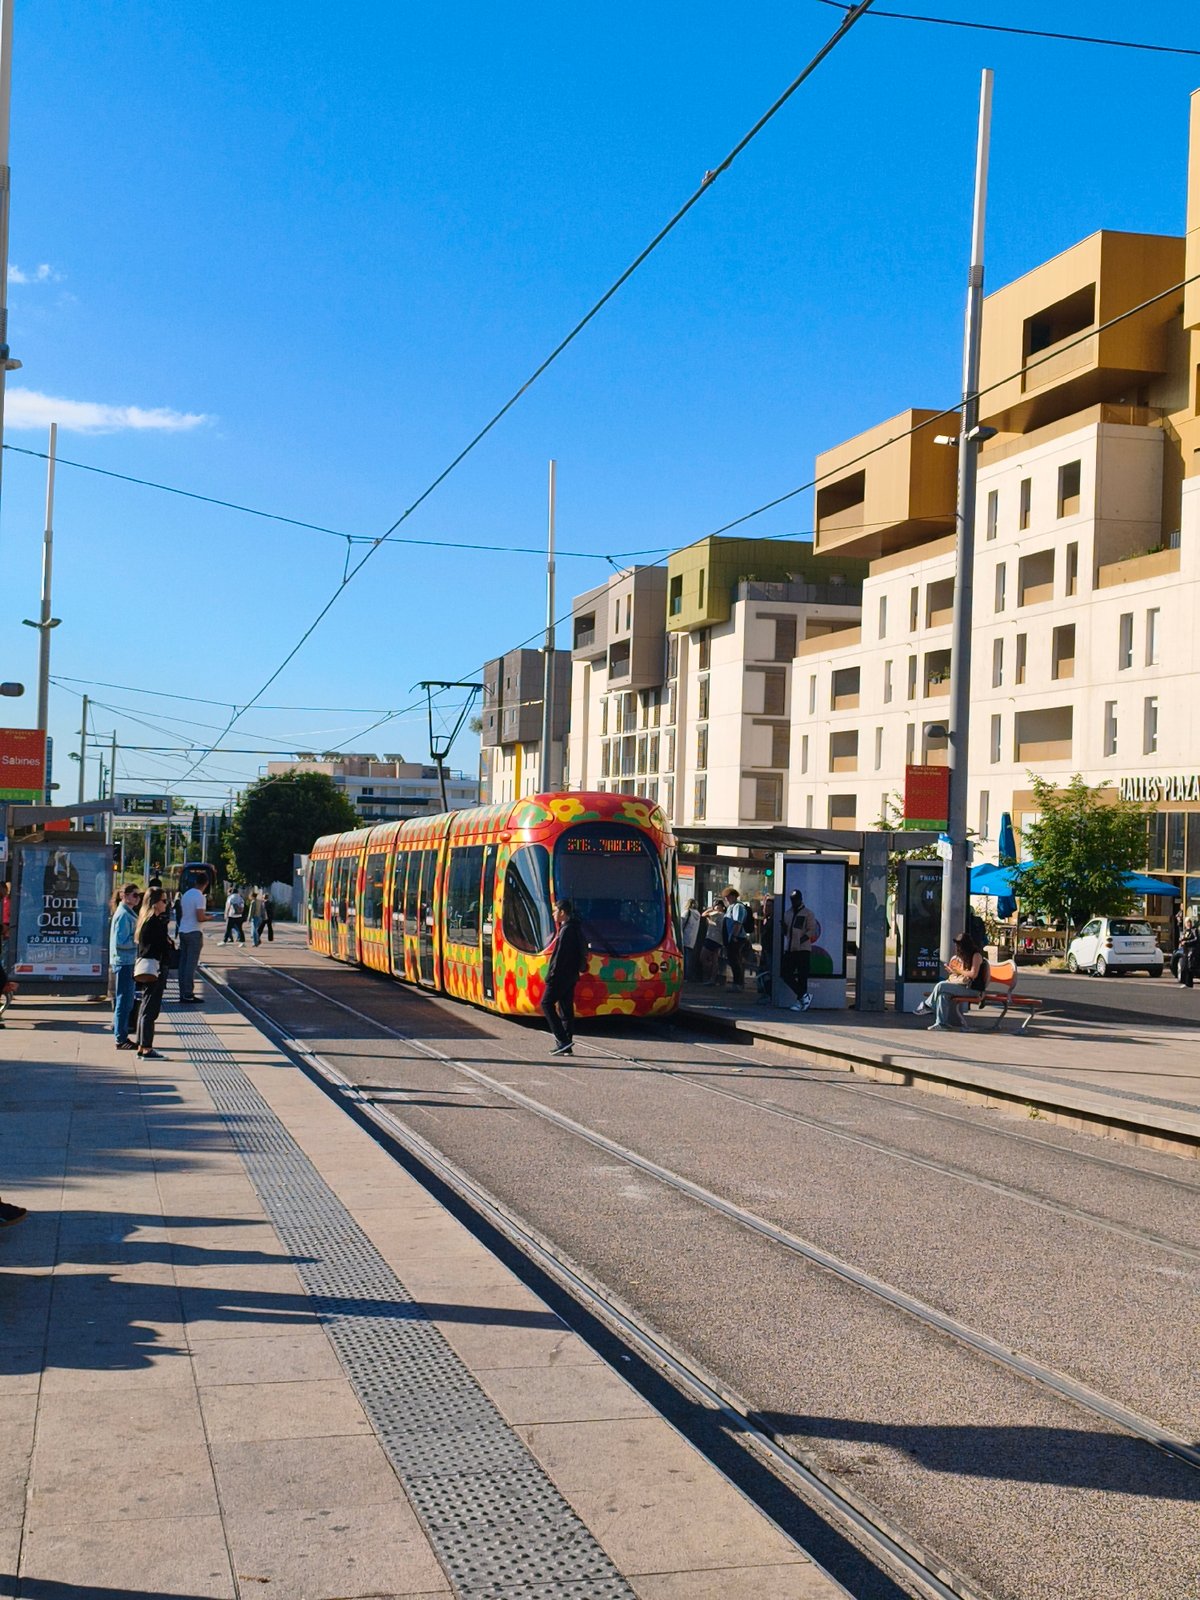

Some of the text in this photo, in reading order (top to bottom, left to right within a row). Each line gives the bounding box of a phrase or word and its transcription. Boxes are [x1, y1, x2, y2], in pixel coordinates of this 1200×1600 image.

[2, 755, 41, 766] Sabines
[1119, 775, 1200, 801] HALLES PLAZA
[42, 895, 79, 908] Tom
[37, 911, 82, 927] Odell
